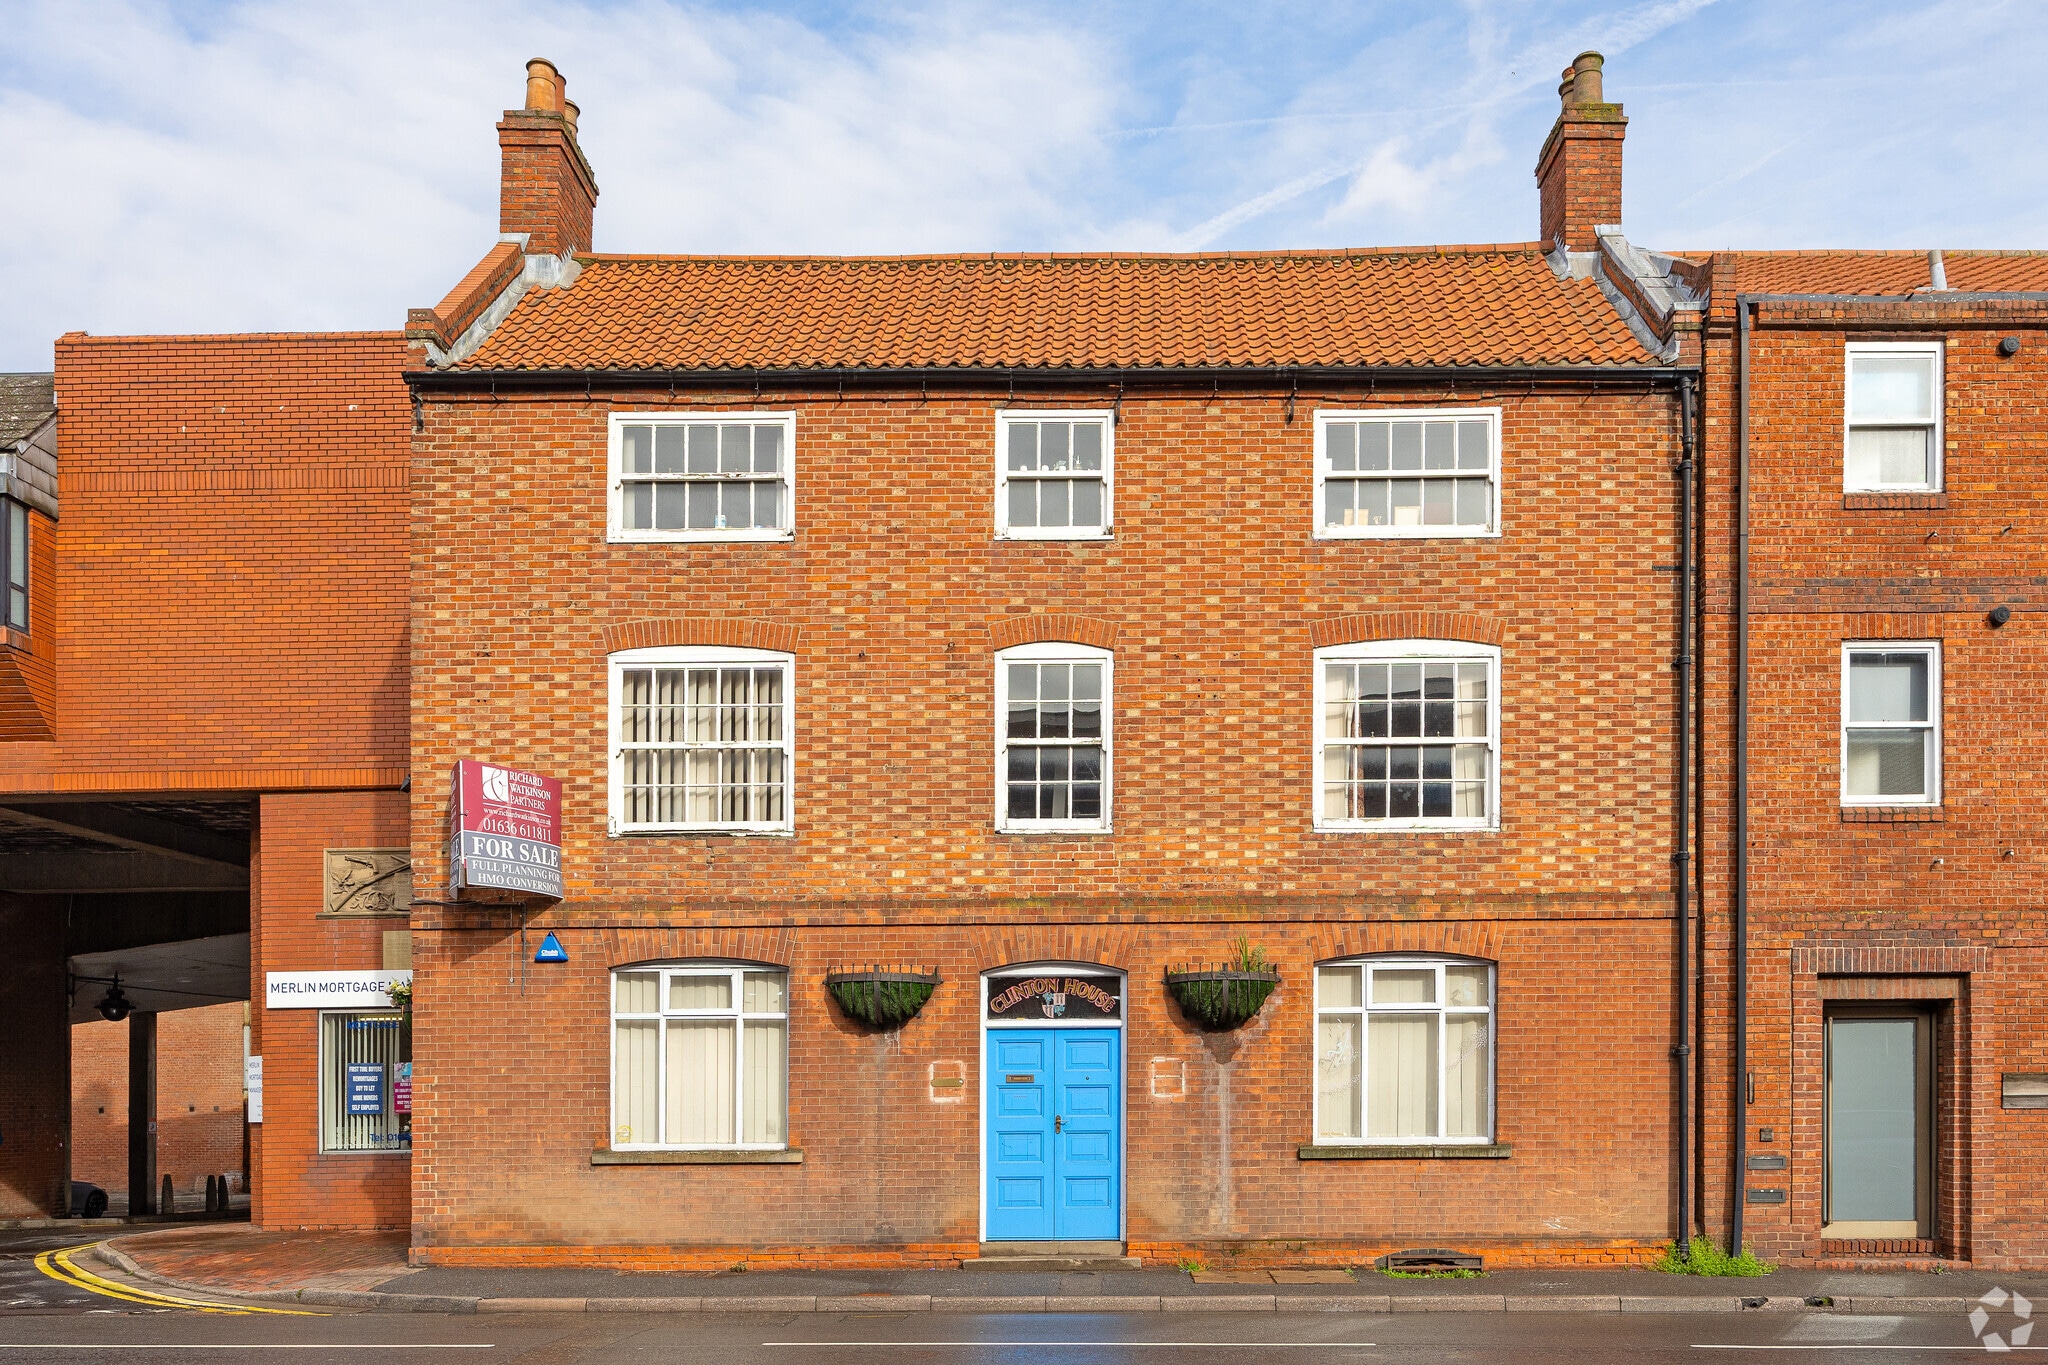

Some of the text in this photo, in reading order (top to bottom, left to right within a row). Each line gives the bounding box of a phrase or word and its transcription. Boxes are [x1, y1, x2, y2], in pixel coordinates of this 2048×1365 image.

[509, 771, 543, 787] RICHARD
[509, 783, 551, 801] WATKINSON
[510, 794, 545, 811] PARTNERS
[483, 817, 551, 842] 01636 611811
[472, 836, 515, 860] FOR
[519, 843, 559, 868] SALE
[472, 860, 561, 883] FULL PLANNING FOR
[478, 872, 559, 894] HMO CONVERSION
[270, 982, 316, 994] MERLIN
[318, 981, 385, 993] MORTGAGE
[990, 977, 1117, 1014] CLINTON HOUSE
